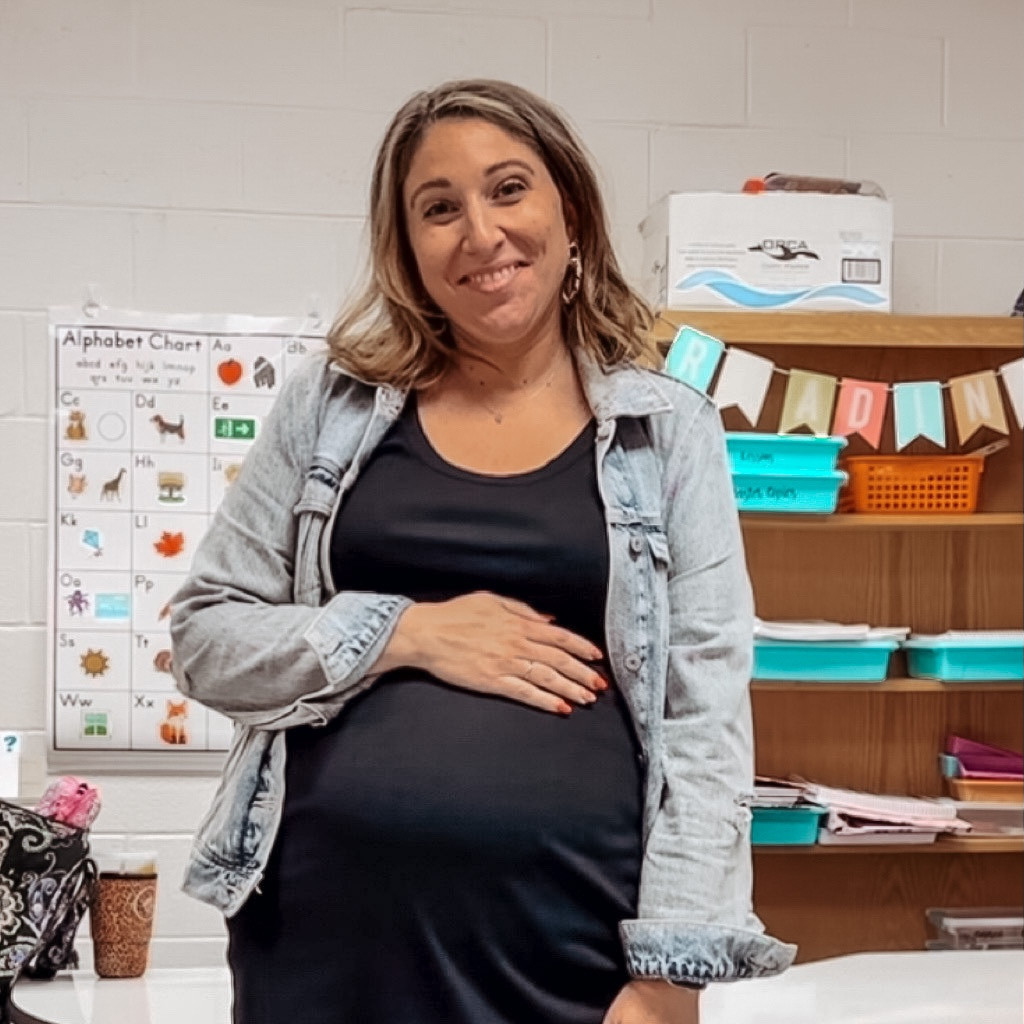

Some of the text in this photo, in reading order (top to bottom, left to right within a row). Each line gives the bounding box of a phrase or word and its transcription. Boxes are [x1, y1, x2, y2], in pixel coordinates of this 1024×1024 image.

[62, 330, 202, 354] Alphabet Chart
[212, 338, 232, 352] Aa
[60, 392, 80, 406] Cc
[135, 394, 156, 409] Dd
[212, 397, 229, 410] Ee
[60, 452, 83, 471] Gg
[135, 456, 154, 469] Hh
[60, 573, 81, 587] Oo
[135, 575, 154, 593] Pp
[60, 633, 75, 648] Ss
[136, 635, 149, 649] Tt
[60, 694, 93, 707] Ww
[134, 695, 154, 708] Xx
